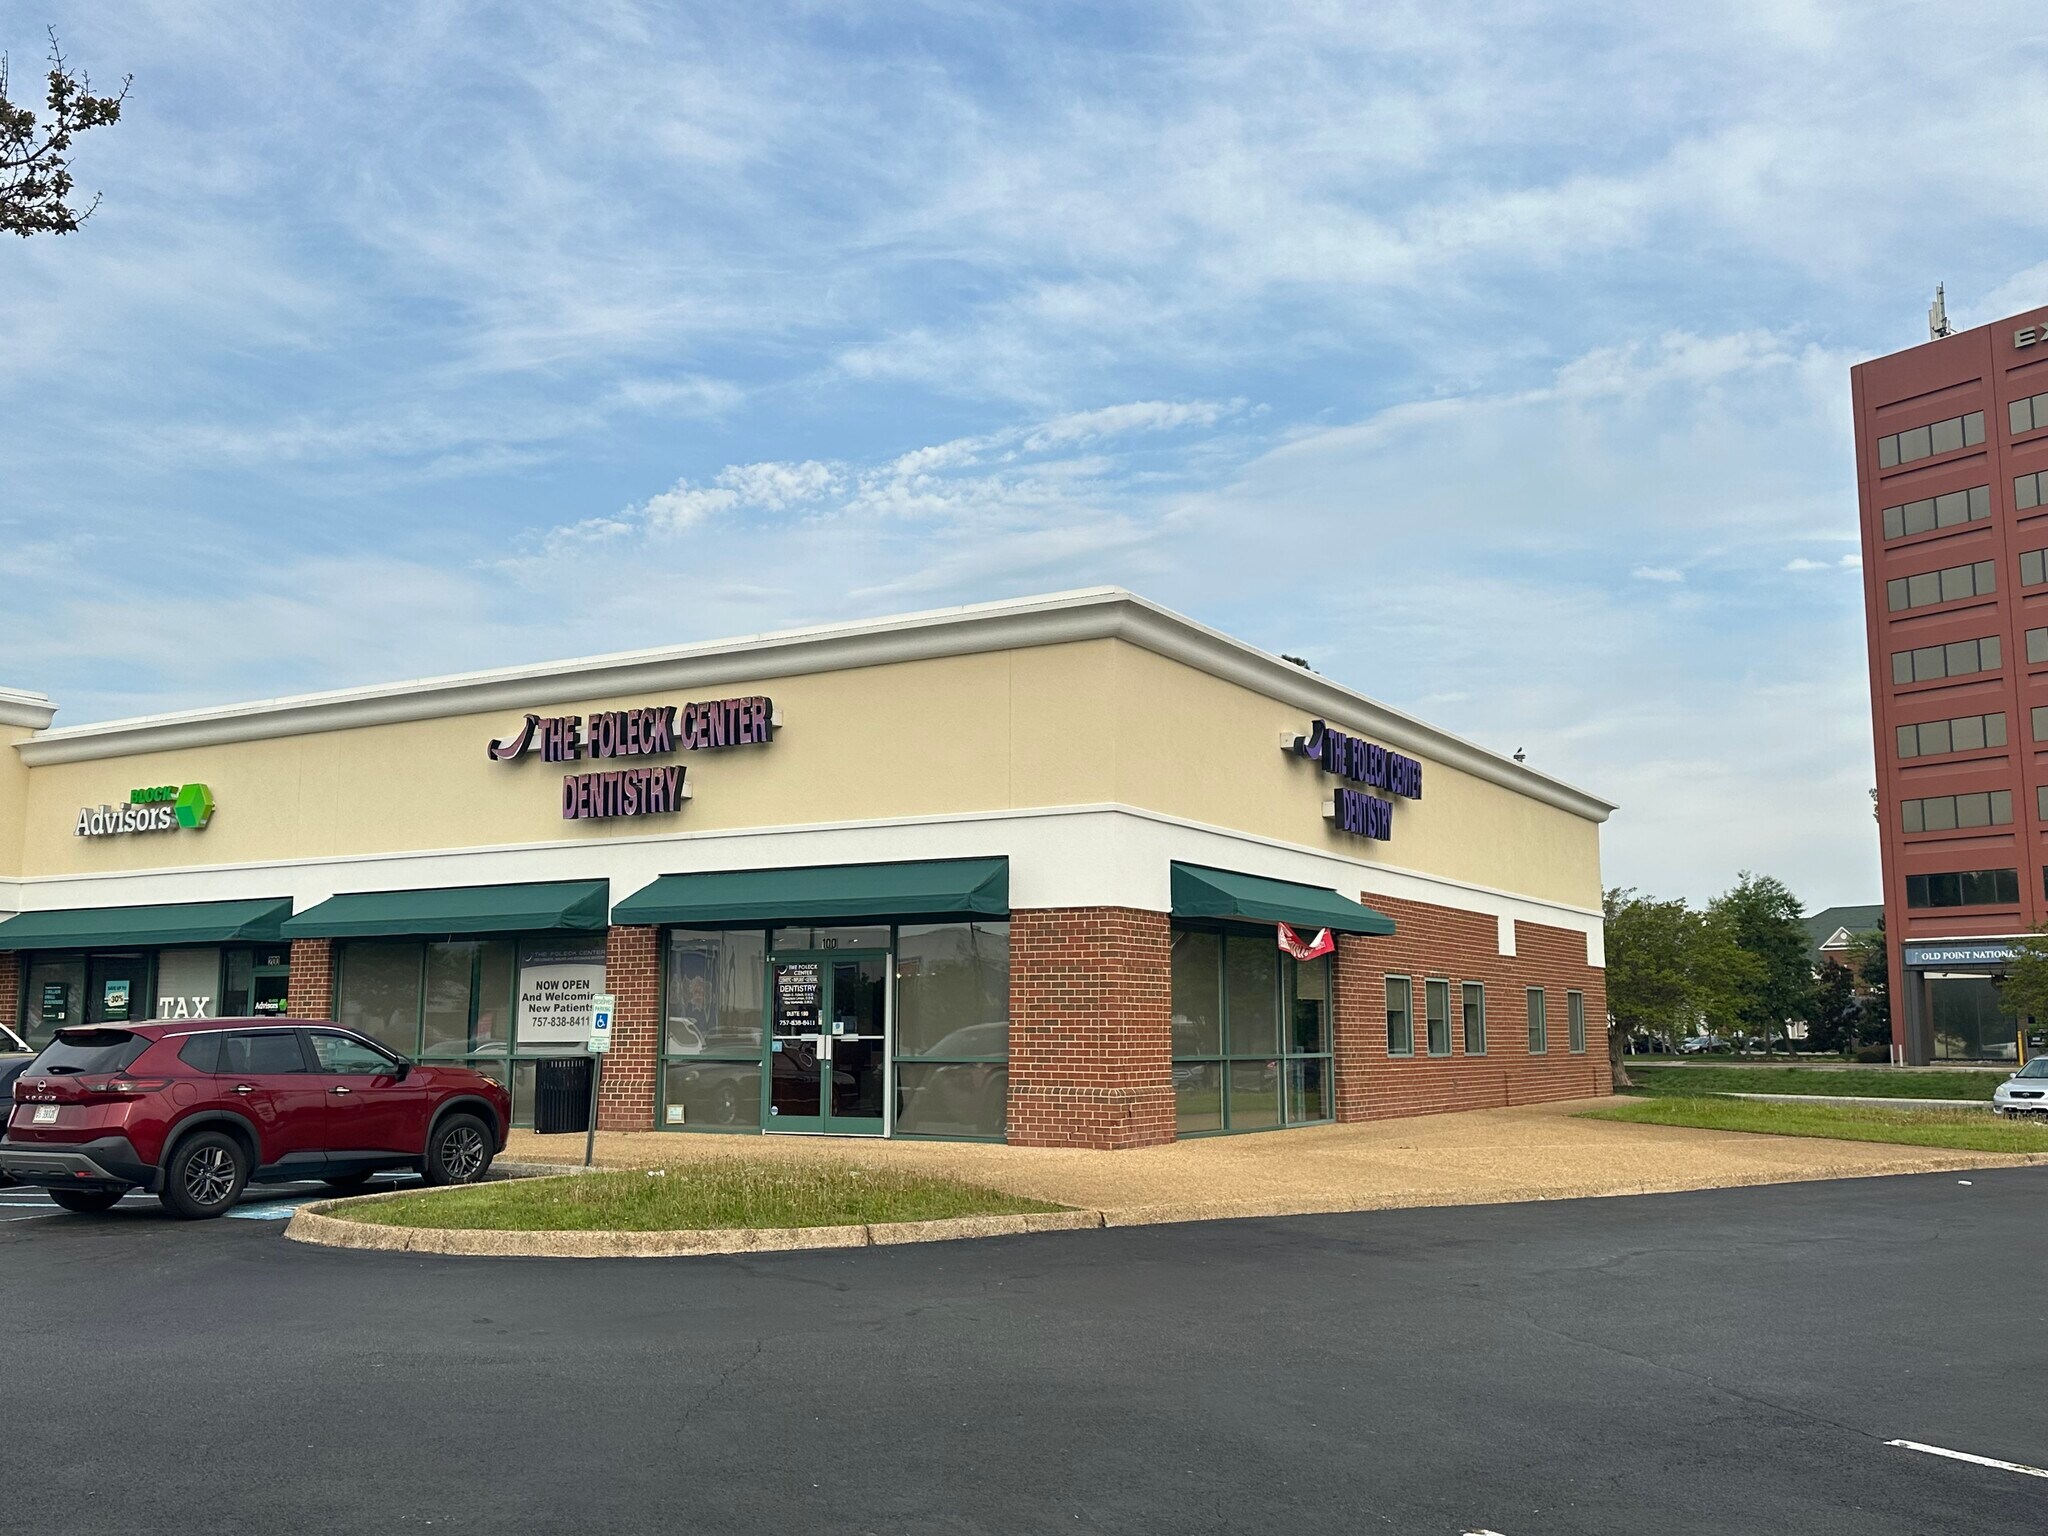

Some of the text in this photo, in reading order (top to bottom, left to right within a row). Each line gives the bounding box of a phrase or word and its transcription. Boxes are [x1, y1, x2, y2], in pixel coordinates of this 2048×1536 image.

[538, 696, 773, 762] THE FOLECK CENTER
[1325, 728, 1422, 800] THE FOLECK CENTER
[130, 786, 175, 804] BLOCK
[563, 765, 687, 819] DENTISTRY
[75, 803, 172, 836] Advisors
[1338, 788, 1393, 841] DENTISTRY
[822, 938, 837, 949] 100
[1921, 952, 1941, 961] OLD
[1943, 951, 1971, 960] POINT
[536, 979, 590, 991] NOW OPEN
[779, 984, 817, 993] DENTISTRY
[521, 991, 594, 1002] And Welcomin
[159, 996, 210, 1019] TAX
[528, 1004, 551, 1013] New
[531, 1016, 590, 1027] 757-838-8411
